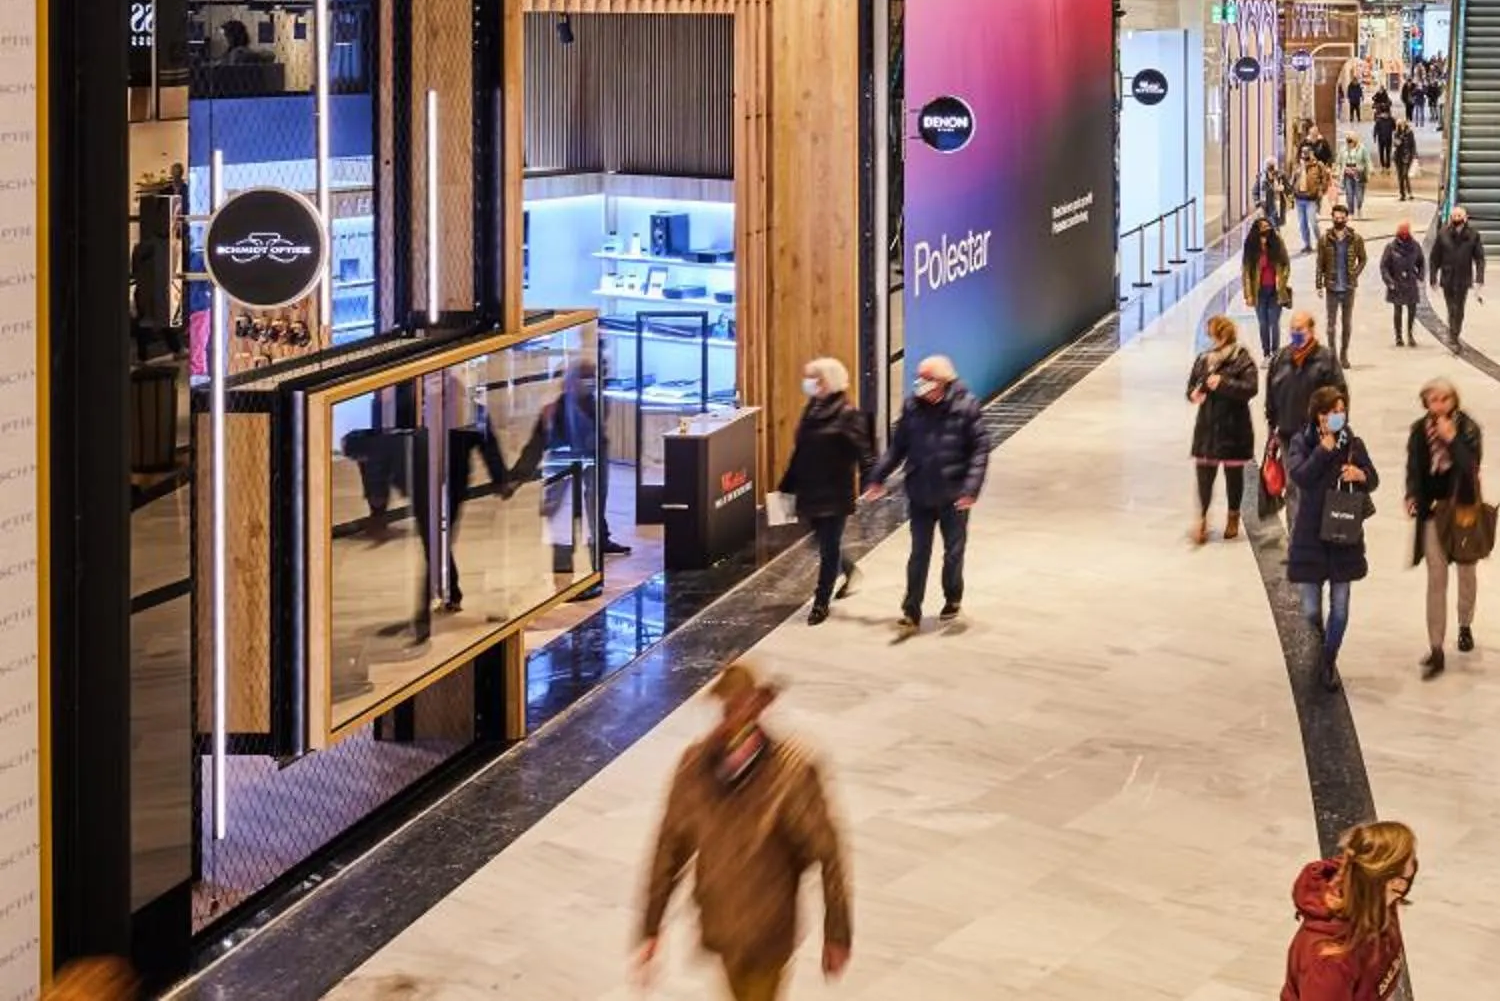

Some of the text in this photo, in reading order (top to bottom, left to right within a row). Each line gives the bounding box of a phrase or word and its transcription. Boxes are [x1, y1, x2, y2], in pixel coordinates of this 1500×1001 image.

[923, 115, 969, 129] DENON
[216, 244, 268, 255] SCHMIDT
[914, 229, 992, 298] Polestar
